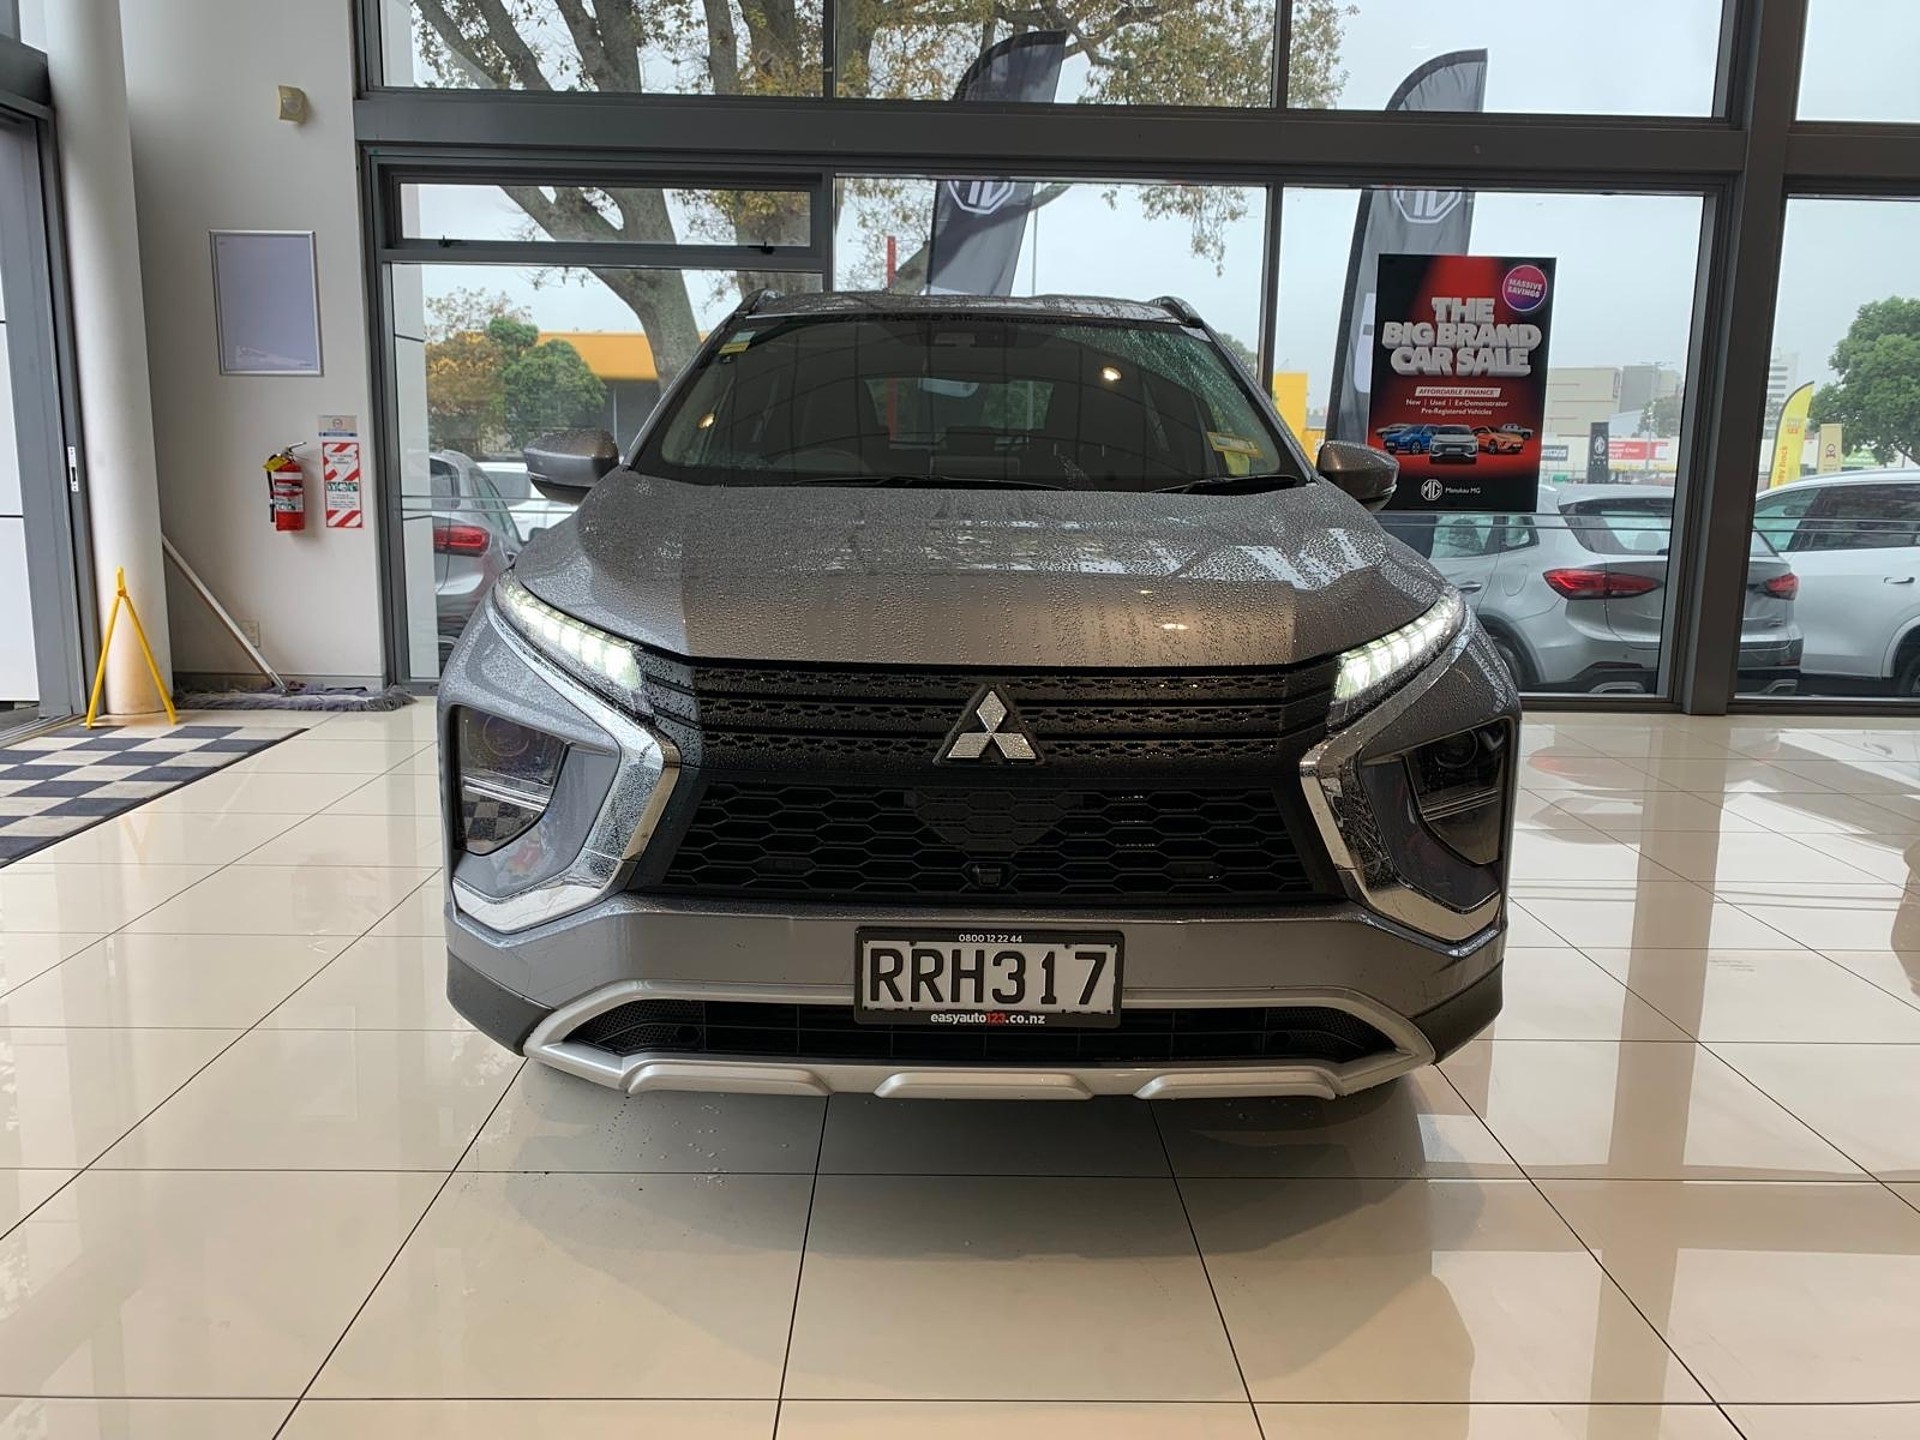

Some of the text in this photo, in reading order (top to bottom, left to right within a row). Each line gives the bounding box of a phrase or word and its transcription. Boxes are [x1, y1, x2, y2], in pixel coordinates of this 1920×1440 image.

[1509, 279, 1543, 291] MASSIVE
[1507, 286, 1540, 298] SAVINGS
[1431, 297, 1495, 323] THE
[1382, 322, 1542, 350] BIG BRAND
[1391, 347, 1532, 376] CAR SALE
[1418, 388, 1463, 396] AFFORDABLE
[1421, 408, 1467, 416] Pre-Registered
[1421, 480, 1442, 500] MG
[958, 933, 1023, 943] 0800 12 22 44
[870, 948, 1107, 1005] RRH317
[930, 1012, 1046, 1025] easyauto123.co.nz
